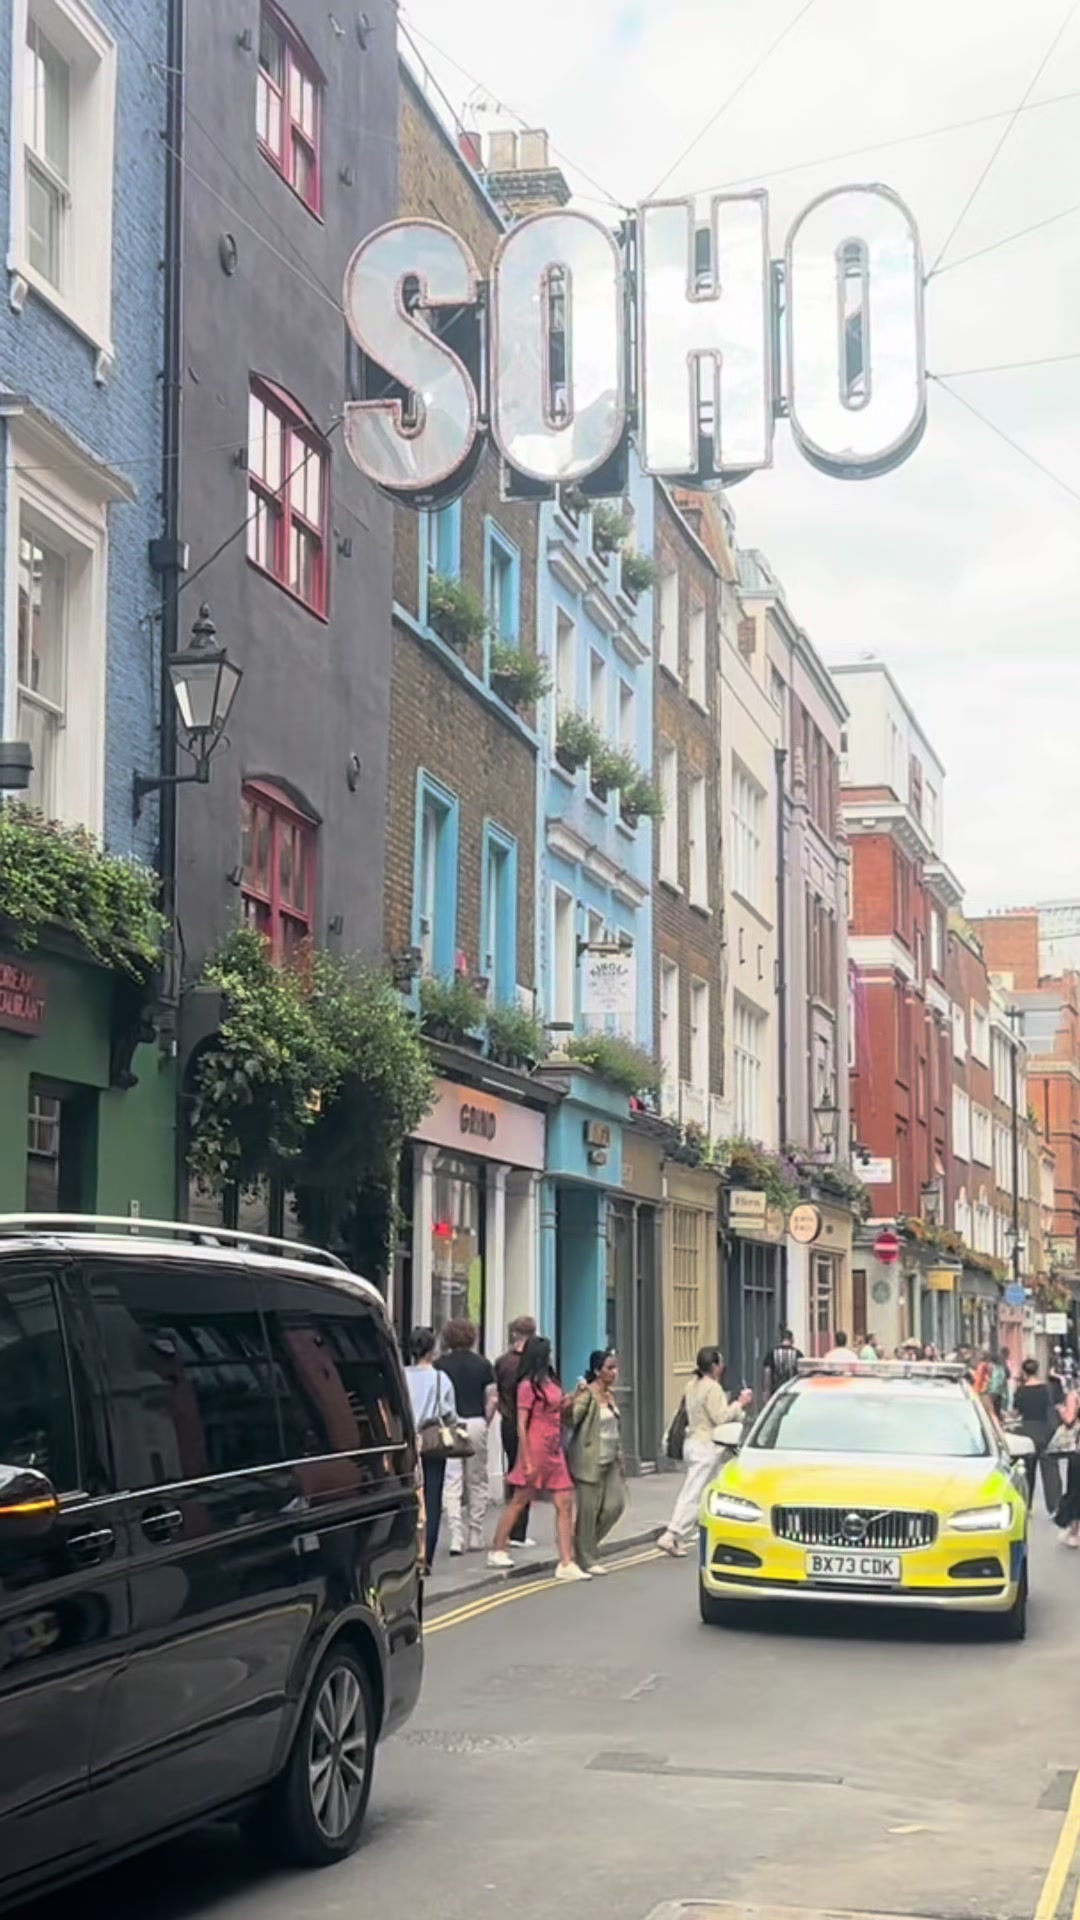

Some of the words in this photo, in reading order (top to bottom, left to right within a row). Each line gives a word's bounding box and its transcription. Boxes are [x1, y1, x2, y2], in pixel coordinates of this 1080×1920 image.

[343, 182, 927, 492] SOHO
[812, 1556, 855, 1573] BX73
[860, 1558, 893, 1575] CDK
